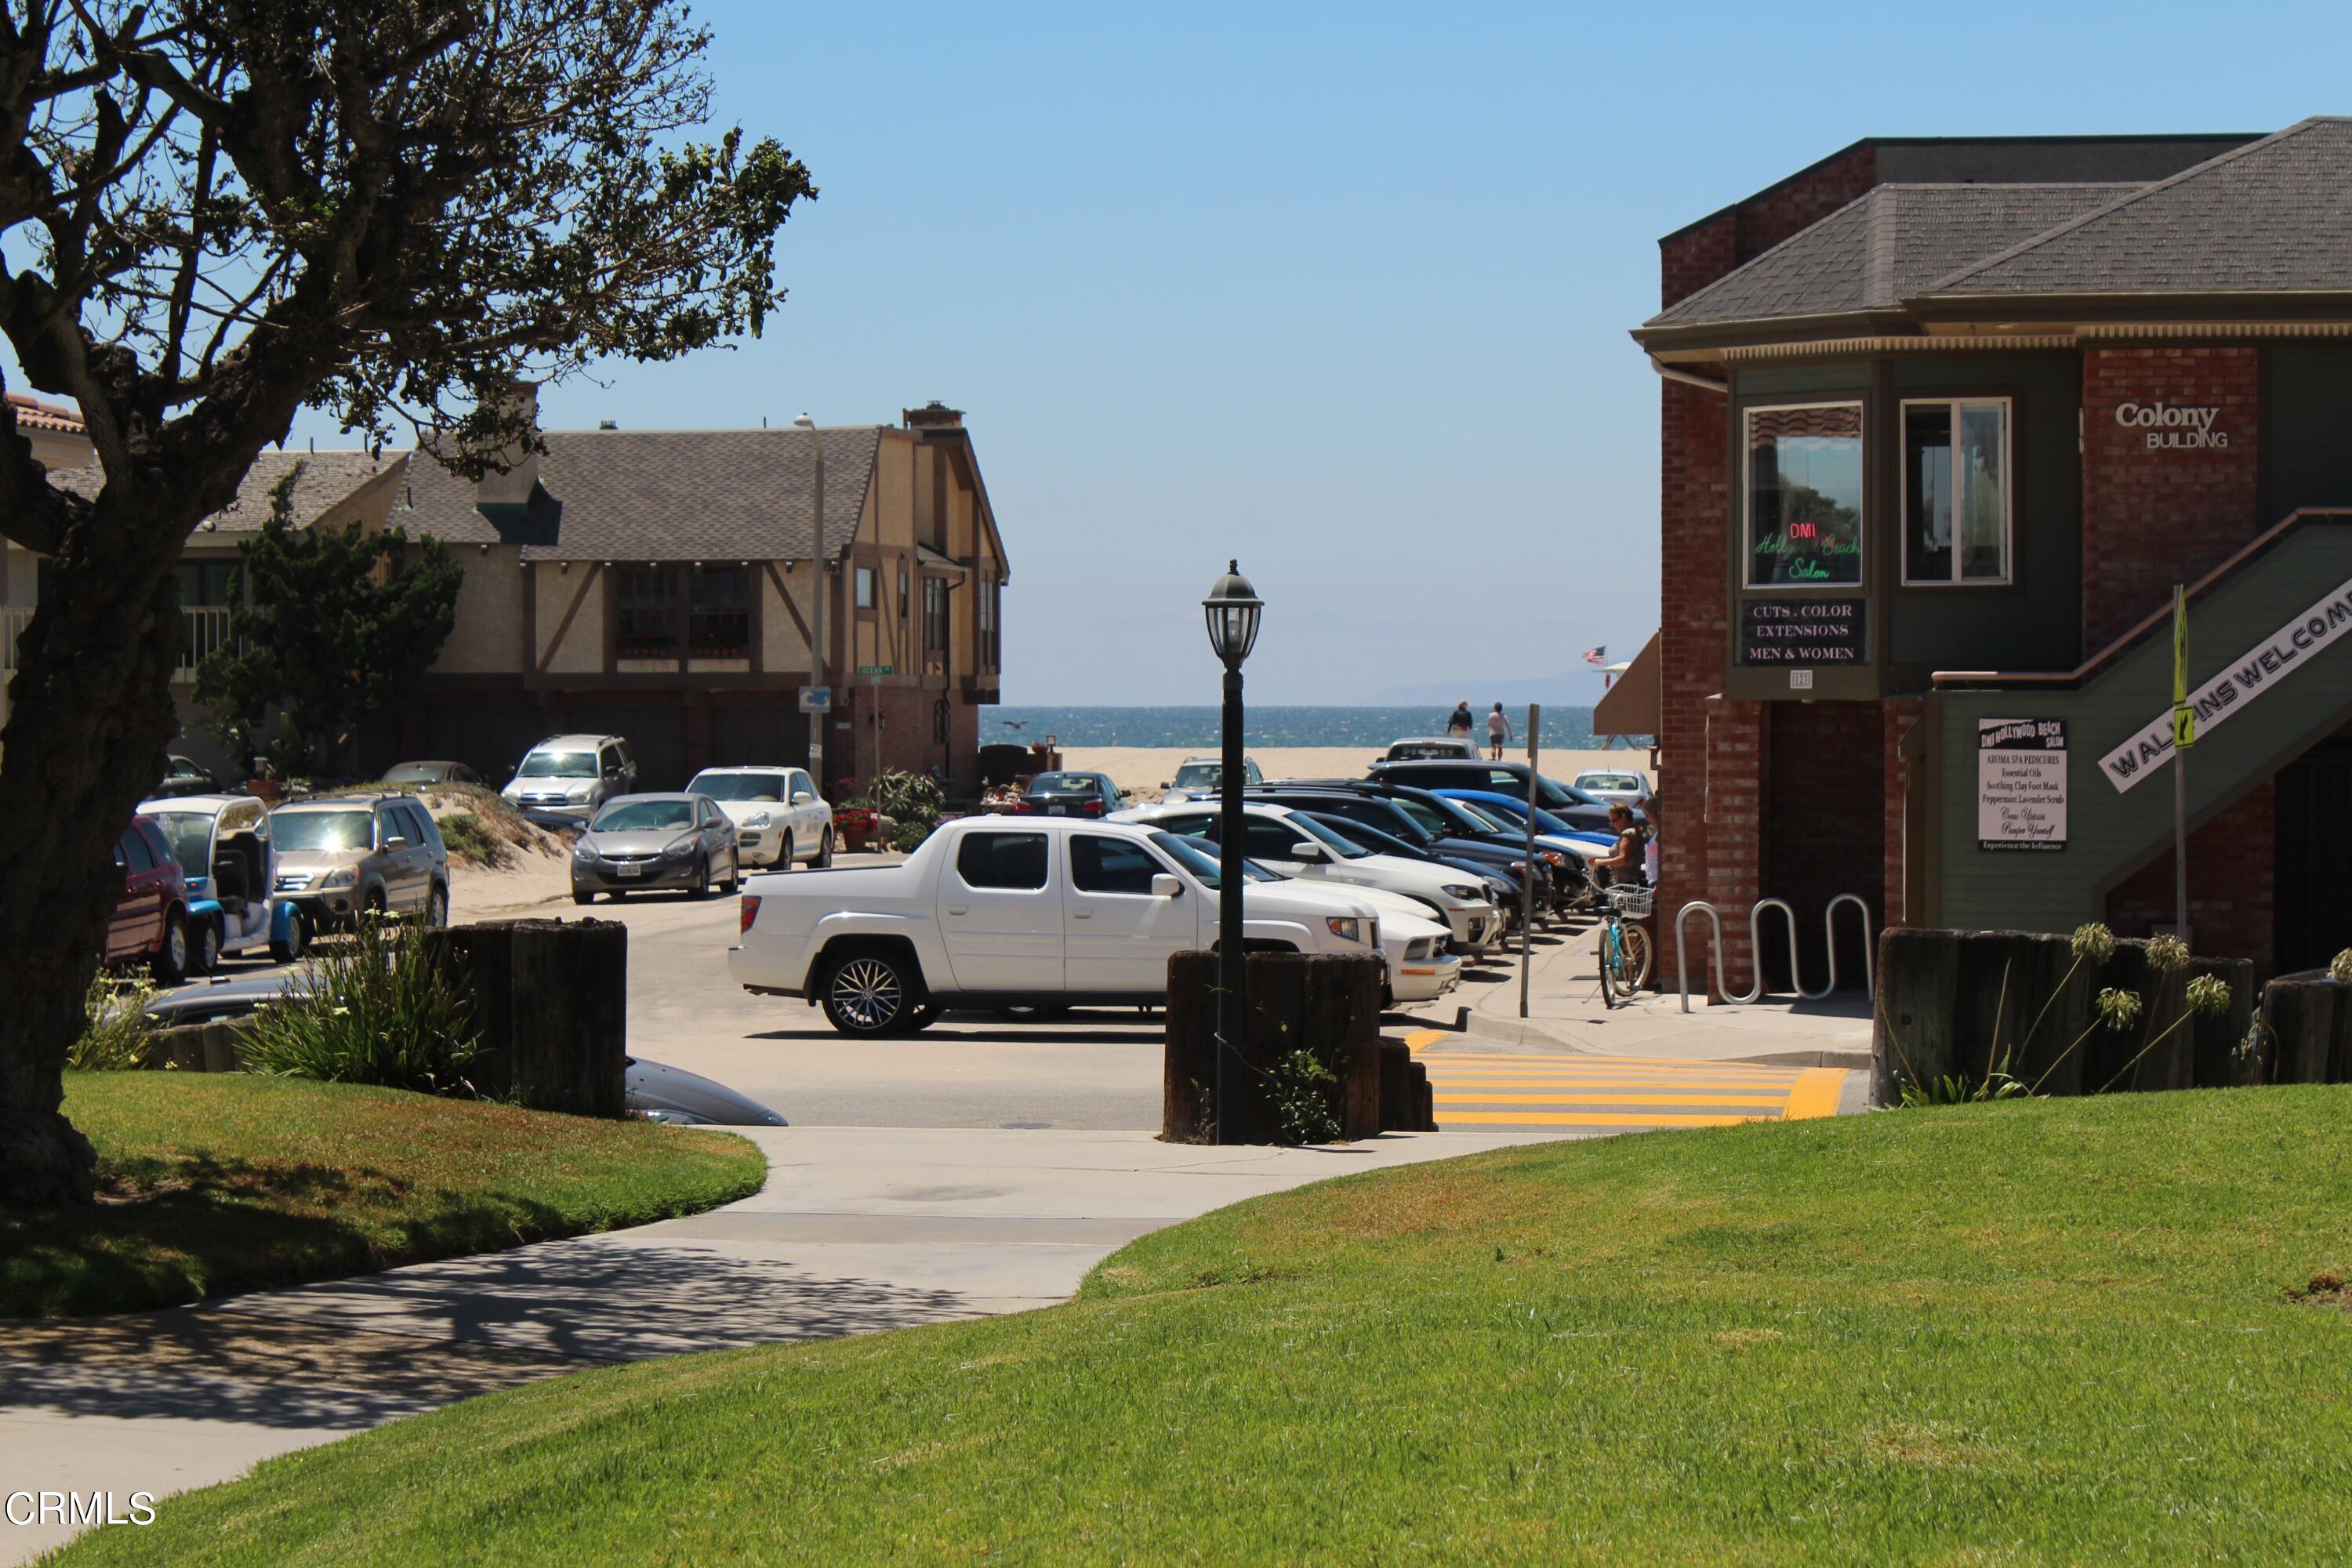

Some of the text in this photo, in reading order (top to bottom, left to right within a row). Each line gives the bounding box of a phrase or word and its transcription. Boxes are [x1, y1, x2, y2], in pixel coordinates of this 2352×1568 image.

[2115, 401, 2220, 434] Colony
[2147, 432, 2228, 448] BUILDING
[1790, 523, 1817, 539] DMI
[1788, 557, 1830, 579] Salon
[1753, 606, 1791, 618] CUTS
[1801, 604, 1853, 617] COLOR
[1757, 624, 1849, 637] EXTENSIONS
[1750, 647, 1854, 659] MEN & WOMEN
[1981, 720, 2061, 748] DMI HOLLYWOOD BEACH
[2045, 735, 2064, 748] SALON
[1987, 754, 2060, 765] AROMA SPA PEDICURES
[2002, 768, 2042, 778] Essential Oils
[1987, 781, 2059, 793] Soothing Clay Foot Mask
[1983, 793, 2064, 806] Peppermint Lavender Scrub
[1984, 841, 2018, 851] Experience
[2020, 841, 2031, 850] the
